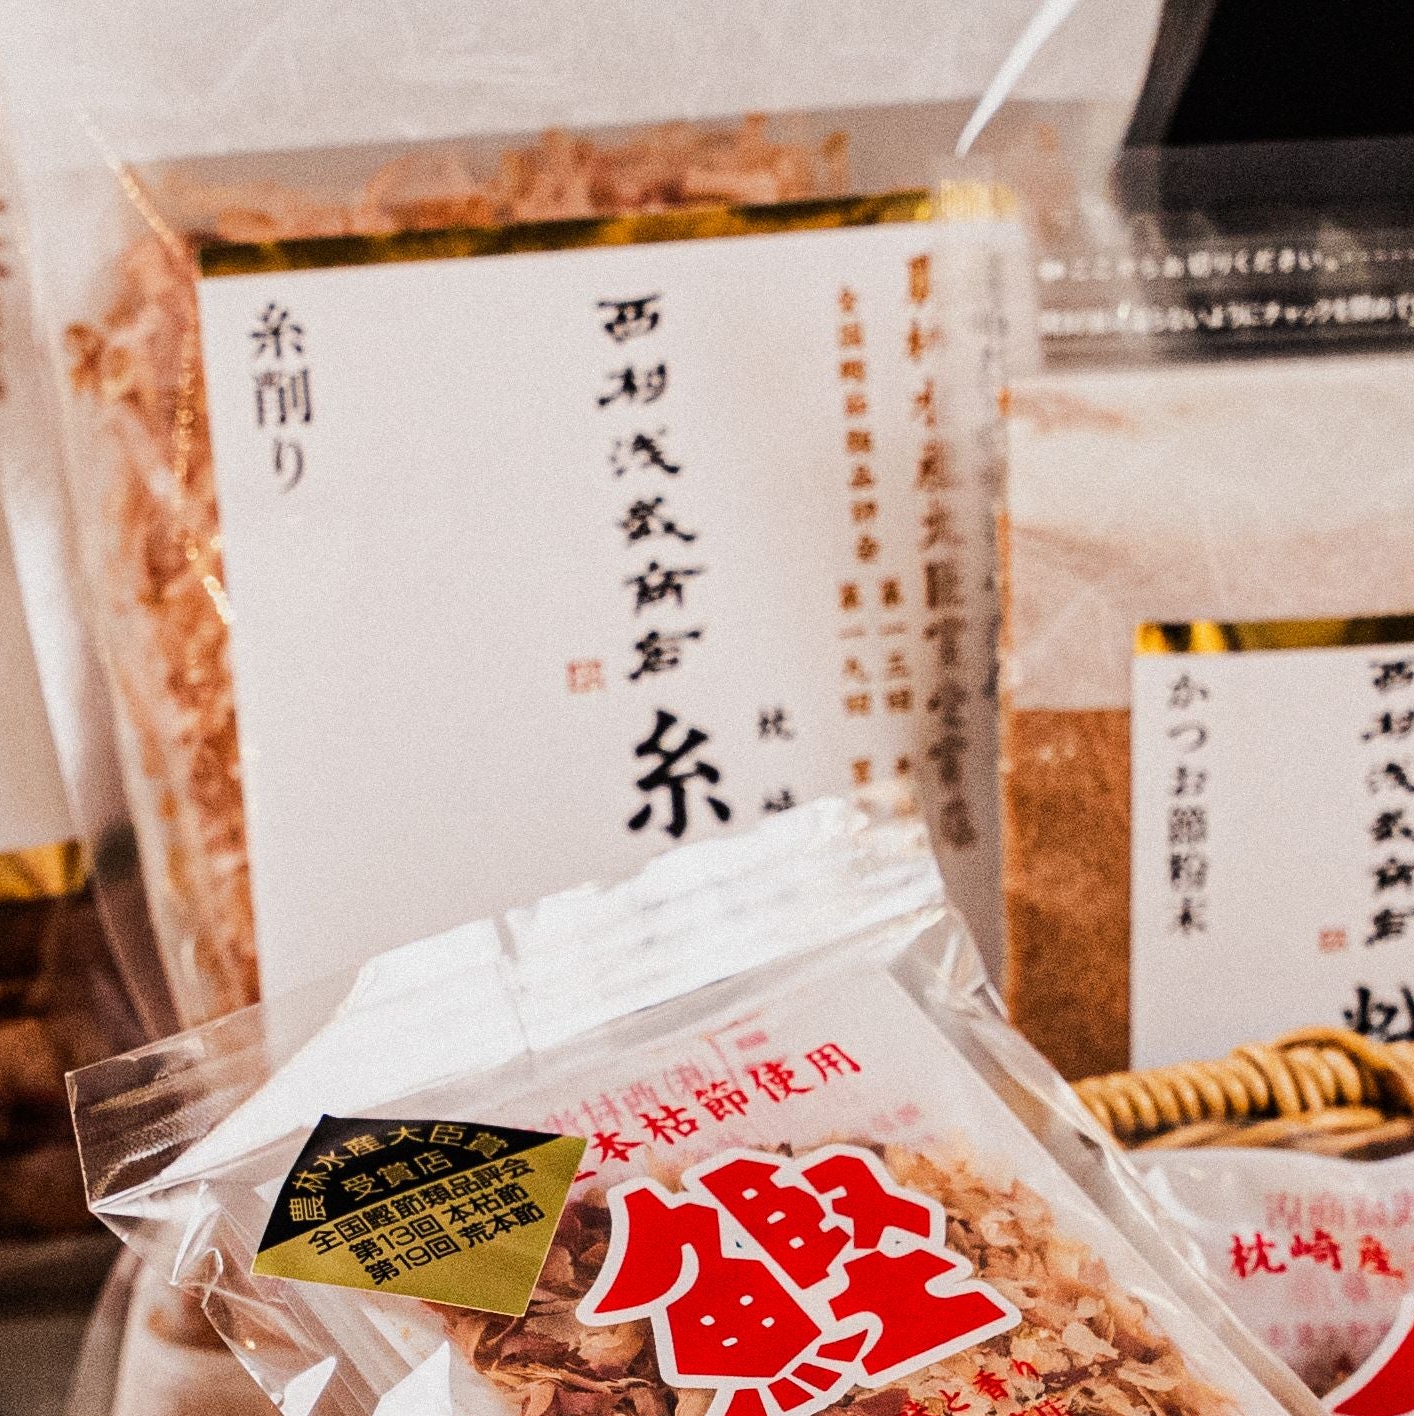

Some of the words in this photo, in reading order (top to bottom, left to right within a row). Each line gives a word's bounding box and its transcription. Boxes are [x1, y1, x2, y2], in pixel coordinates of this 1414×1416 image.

[250, 302, 313, 493] 糸削り
[573, 1043, 861, 1182] 本枯節使用
[289, 1123, 509, 1222] 農林水産大臣賞
[307, 1156, 536, 1256] 全国鰹節類品評会
[340, 1150, 453, 1201] 受賞店
[347, 1214, 444, 1261] 第13回
[441, 1183, 530, 1226] 本枯節
[365, 1234, 463, 1286] 第19回
[459, 1201, 545, 1249] 荒本節
